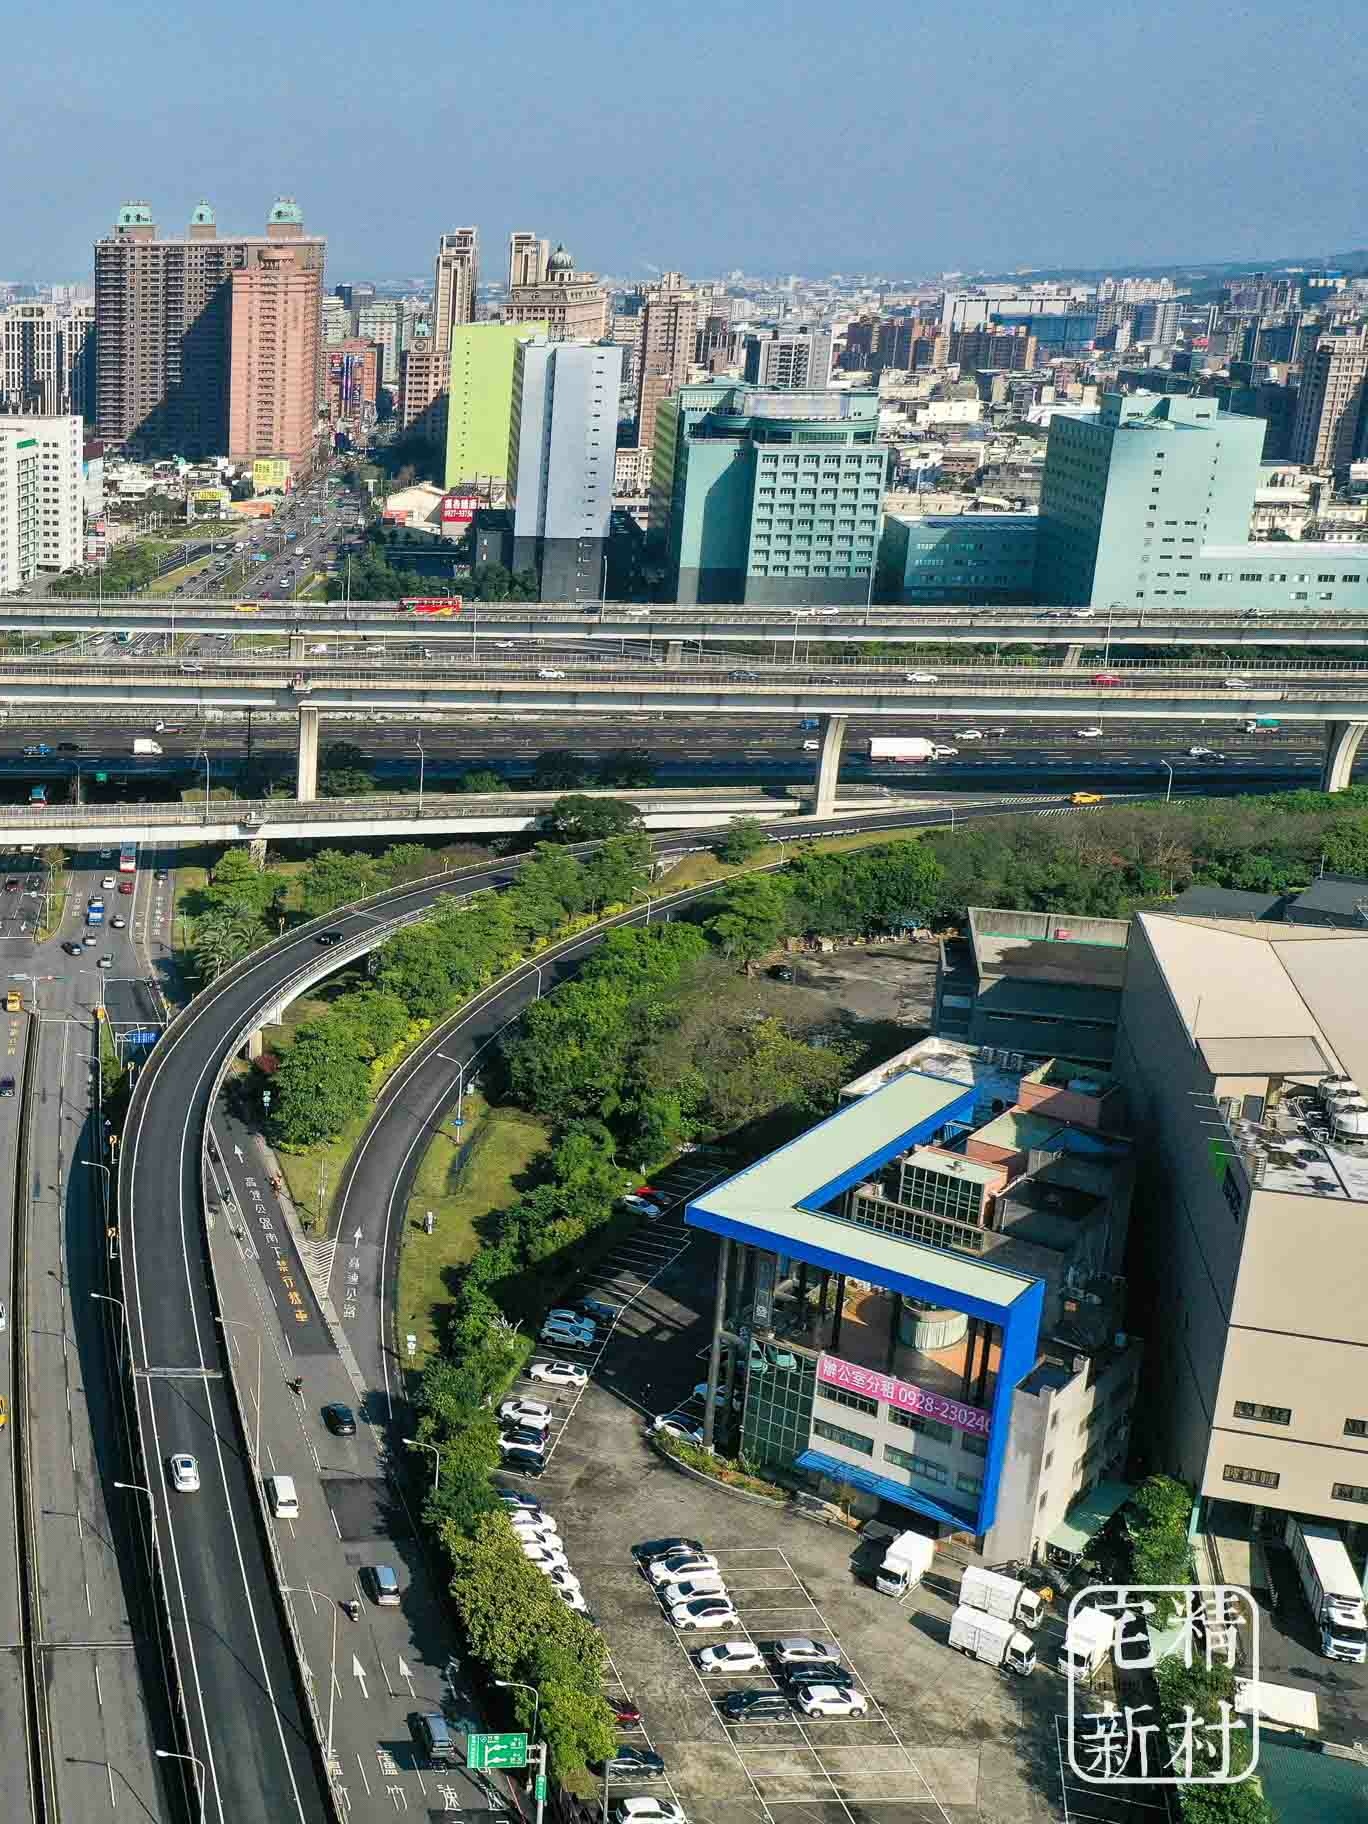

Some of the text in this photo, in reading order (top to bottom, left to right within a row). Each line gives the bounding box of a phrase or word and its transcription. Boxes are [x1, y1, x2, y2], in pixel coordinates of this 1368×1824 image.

[823, 1358, 897, 1400] 辦公室分租
